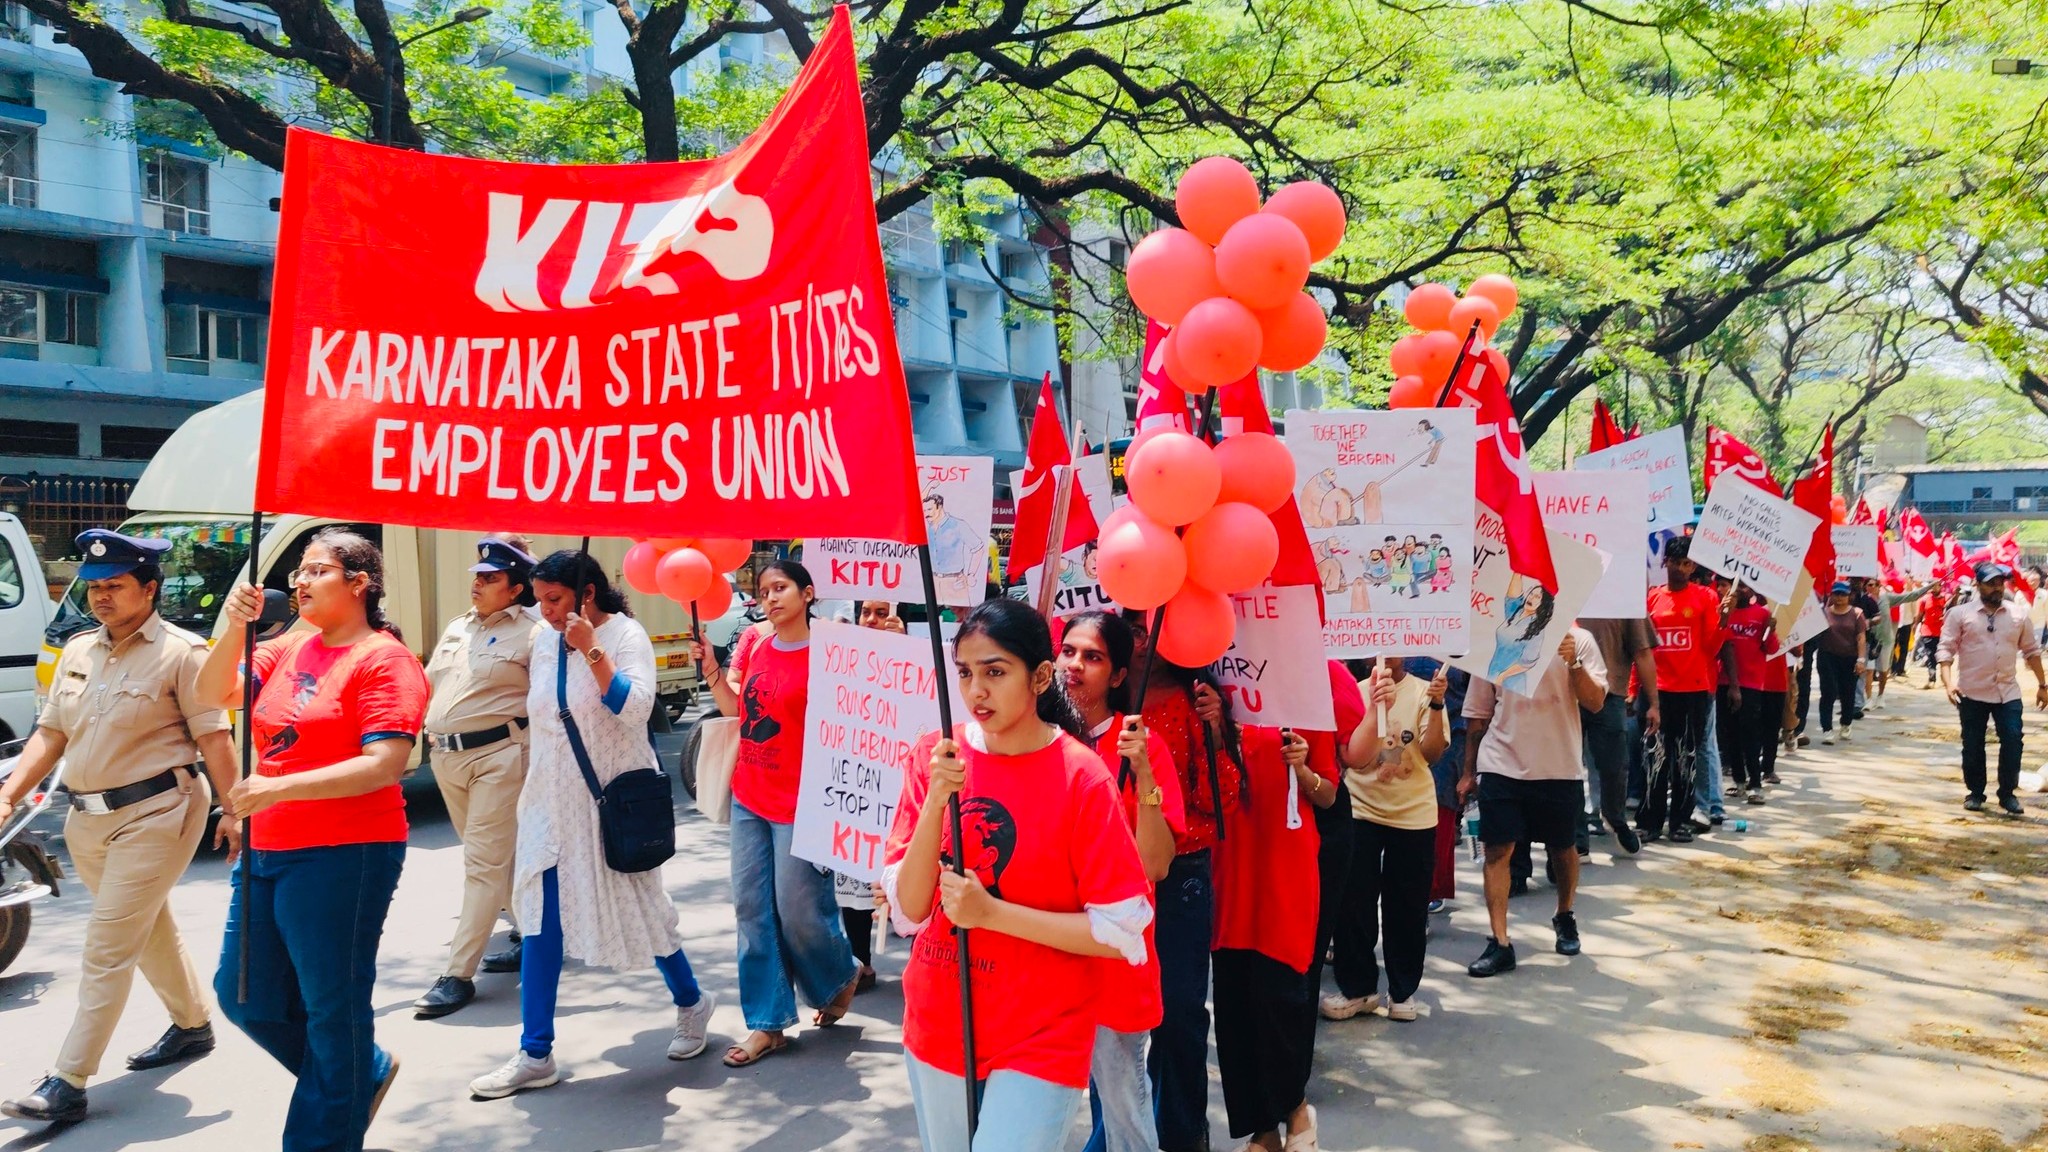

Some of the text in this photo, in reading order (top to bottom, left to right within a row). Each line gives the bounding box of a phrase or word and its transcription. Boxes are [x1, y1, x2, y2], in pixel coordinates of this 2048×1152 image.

[306, 327, 581, 409] KARNATAKA
[605, 312, 742, 407] STATE
[1310, 424, 1367, 441] TOGETHER
[1337, 440, 1356, 452] WE
[371, 406, 850, 503] EMPLOYEES UNION
[1337, 453, 1395, 466] BARGAIN
[928, 466, 970, 482] JUST
[1545, 495, 1609, 515] HAVE A
[820, 537, 919, 560] AGAINST OVERWORK
[831, 558, 901, 589] KITU
[1723, 554, 1760, 581] KITU
[1378, 617, 1411, 631] STATE
[1419, 616, 1462, 631] IT/ITES
[1322, 633, 1441, 647] EMPLOYEES UNION
[824, 642, 937, 700] YOUR SYSTEM
[836, 684, 898, 731] RUNS ON
[820, 719, 910, 768] OUR LABOUR
[831, 757, 881, 793] WE CAN
[824, 786, 894, 828] STOP IT
[832, 820, 887, 870] KIT
